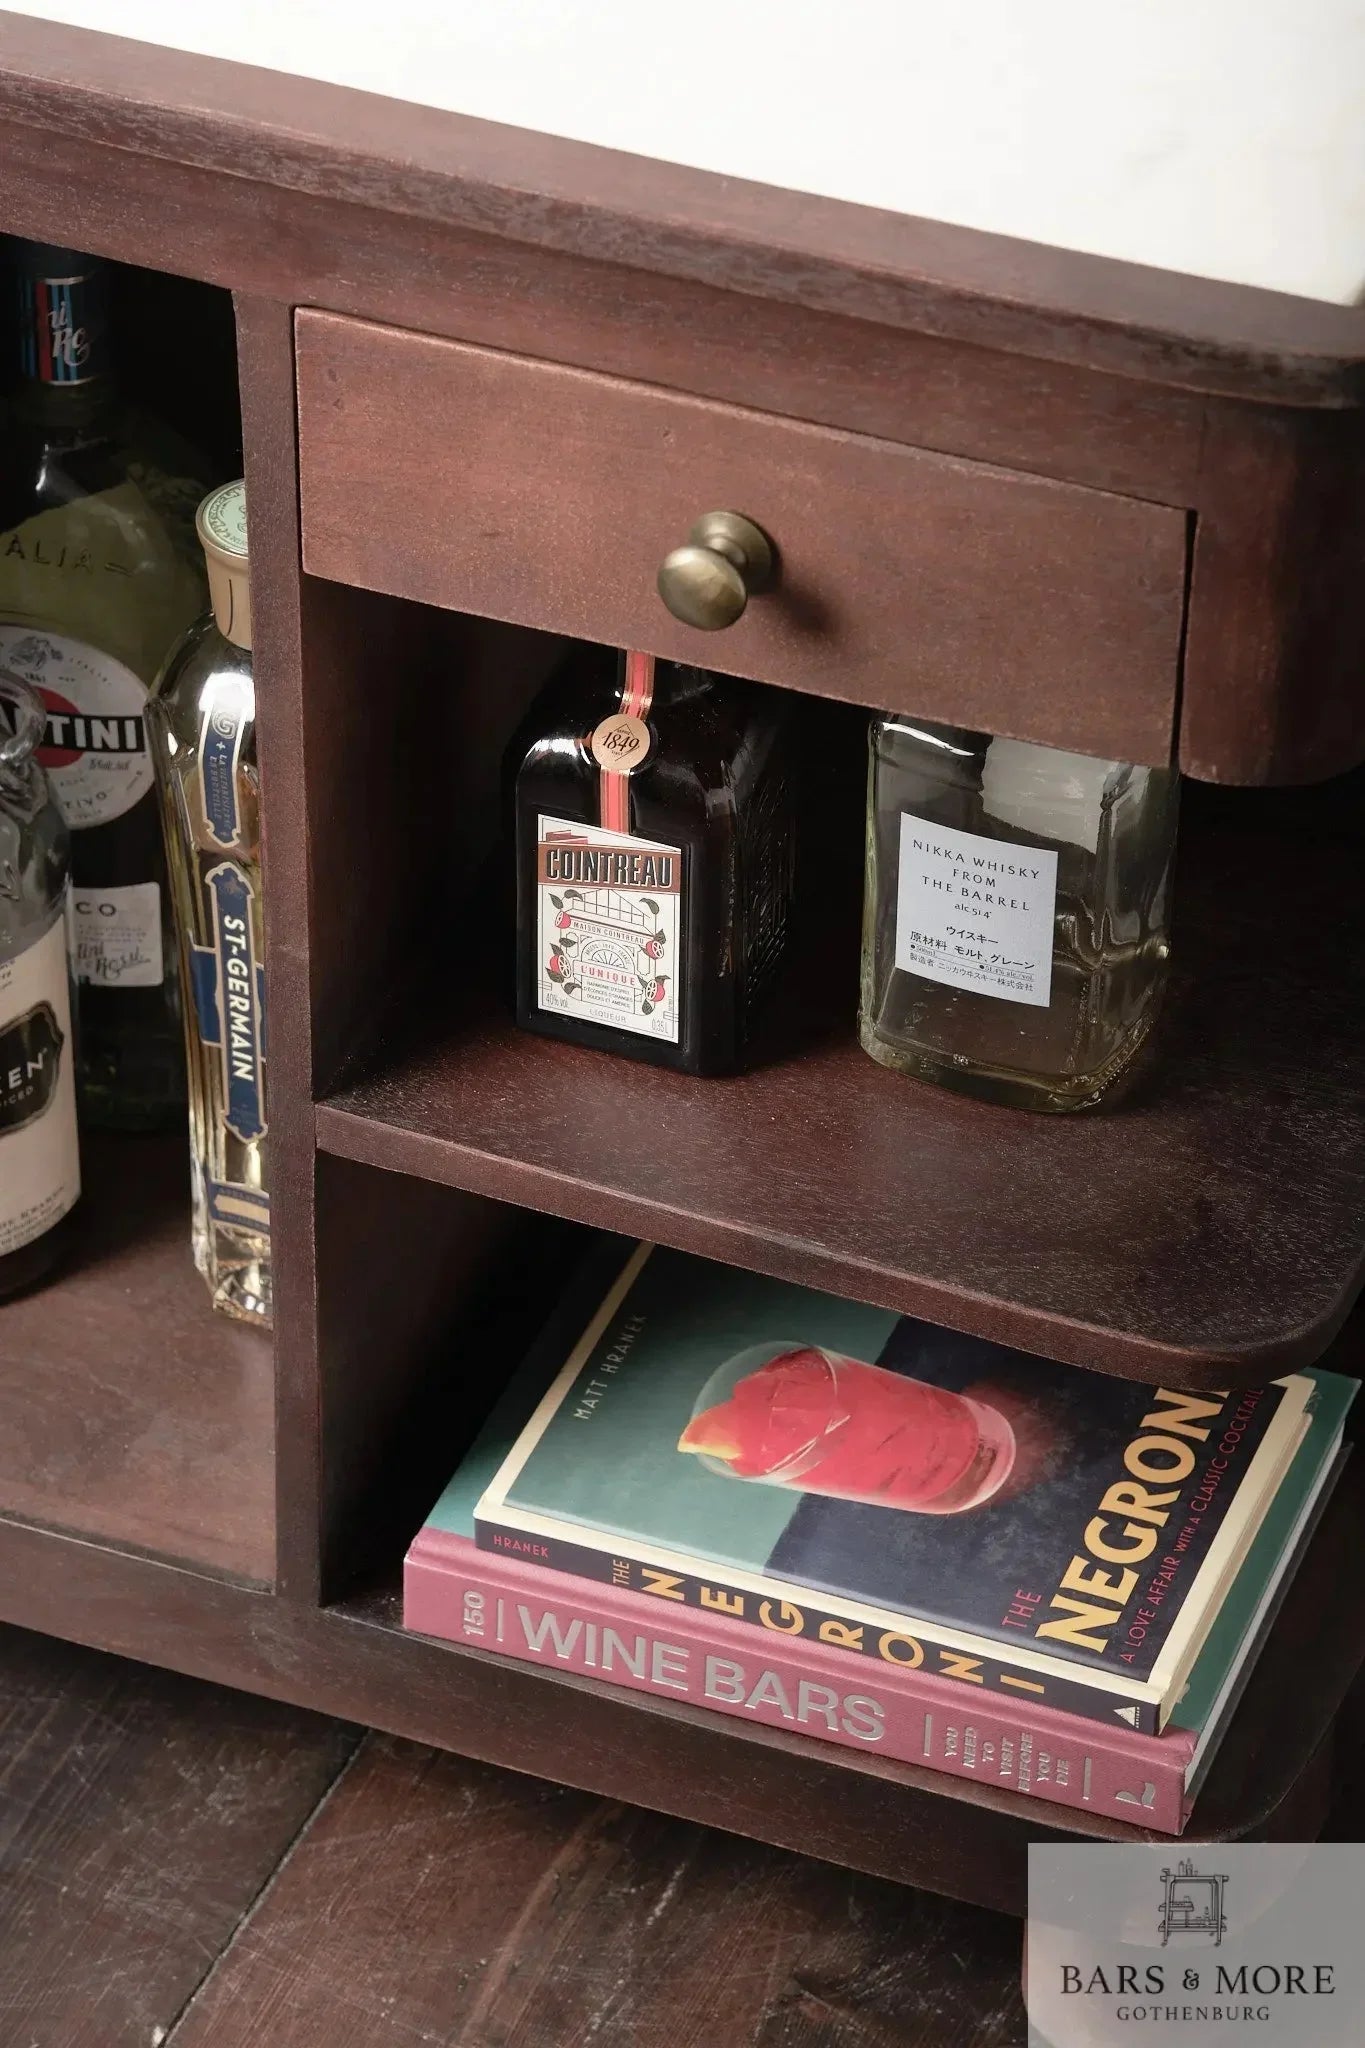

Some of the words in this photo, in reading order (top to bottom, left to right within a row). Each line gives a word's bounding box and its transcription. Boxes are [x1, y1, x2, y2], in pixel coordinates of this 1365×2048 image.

[602, 731, 640, 752] 1849
[546, 848, 672, 888] COINTREAU
[913, 839, 965, 863] NIKKA
[973, 857, 1040, 880] WHISKY
[953, 868, 996, 888] FROM
[922, 875, 953, 893] THE
[961, 887, 1030, 911] BARREL
[573, 921, 601, 933] MAISON
[604, 928, 644, 944] COINTREAU
[910, 931, 947, 951] 原材料
[946, 926, 999, 944] ウイスキー
[581, 965, 635, 986] L'UNIQUE
[574, 1378, 608, 1420] MATT
[600, 1312, 649, 1374] HRANEK
[1218, 1388, 1265, 1454] COCKTAIL
[1190, 1456, 1228, 1512] CLASSIC
[1034, 1387, 1232, 1654] NEGRON
[1173, 1525, 1192, 1552] WITH
[1190, 1516, 1201, 1527] A
[493, 1535, 549, 1559] HRANEK
[1147, 1555, 1182, 1606] AFFAIR
[463, 1590, 485, 1636] 150
[612, 1559, 630, 1586] THE
[641, 1568, 1045, 1694] NEGRONI
[1002, 1588, 1042, 1629] THE
[1128, 1607, 1156, 1648] LOVE
[516, 1604, 690, 1691] WINE
[704, 1654, 885, 1742] BARS
[1120, 1651, 1136, 1664] A
[944, 1727, 959, 1757] YOU
[963, 1726, 977, 1769] NEED
[982, 1741, 995, 1762] TO
[1000, 1737, 1014, 1776] VISIT
[1018, 1732, 1033, 1792] BEFORE
[1036, 1751, 1051, 1782] YOU
[1056, 1758, 1069, 1786] DIE
